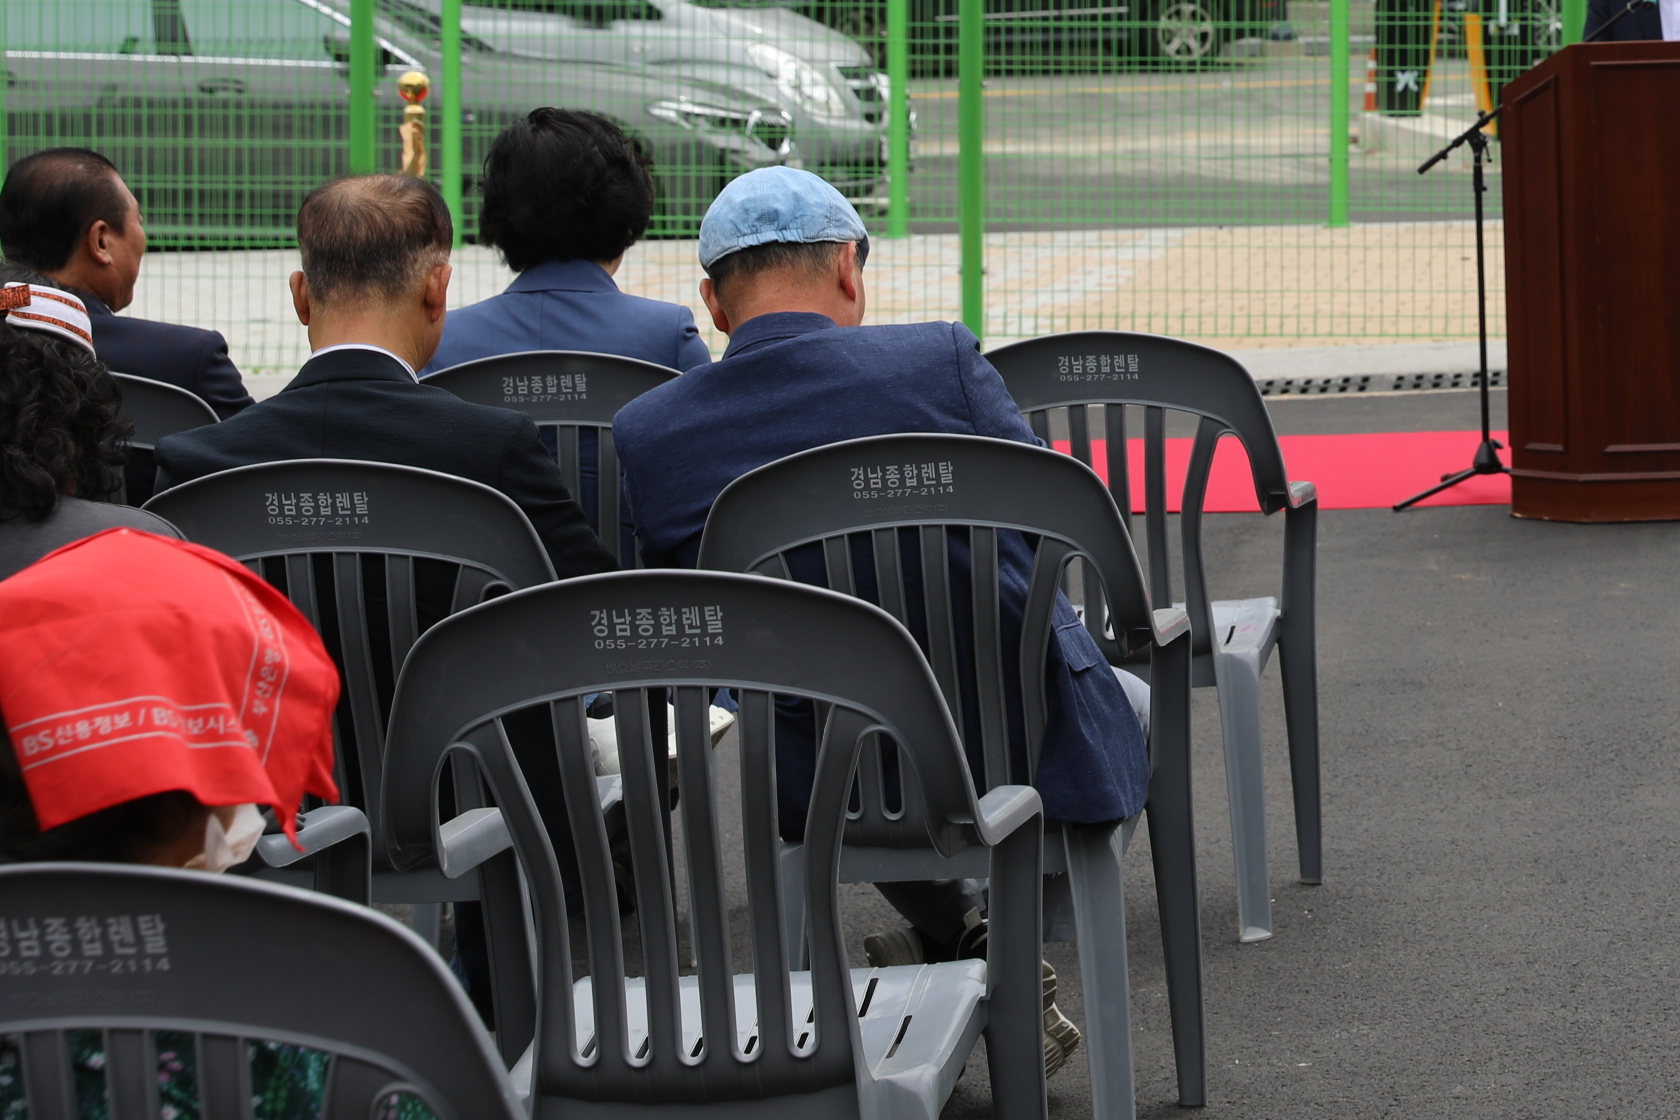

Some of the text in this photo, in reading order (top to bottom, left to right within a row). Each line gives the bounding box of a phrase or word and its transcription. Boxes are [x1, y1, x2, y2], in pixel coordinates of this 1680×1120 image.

[1058, 354, 1139, 373] 경남종합렌탈
[502, 374, 587, 394] 경남종합렌탈
[1060, 373, 1139, 382] 055-277-2114
[504, 393, 587, 403] 055-277-2114
[850, 461, 954, 489] 경남종합렌탈
[853, 485, 954, 499] 055-277-2114
[265, 491, 369, 515] 경남종합렌탈
[268, 516, 370, 526] 055-277-2114
[590, 605, 723, 637] 경남종합렌탈
[594, 636, 724, 649] 055-277-2114
[21, 711, 133, 756] BS신용정보
